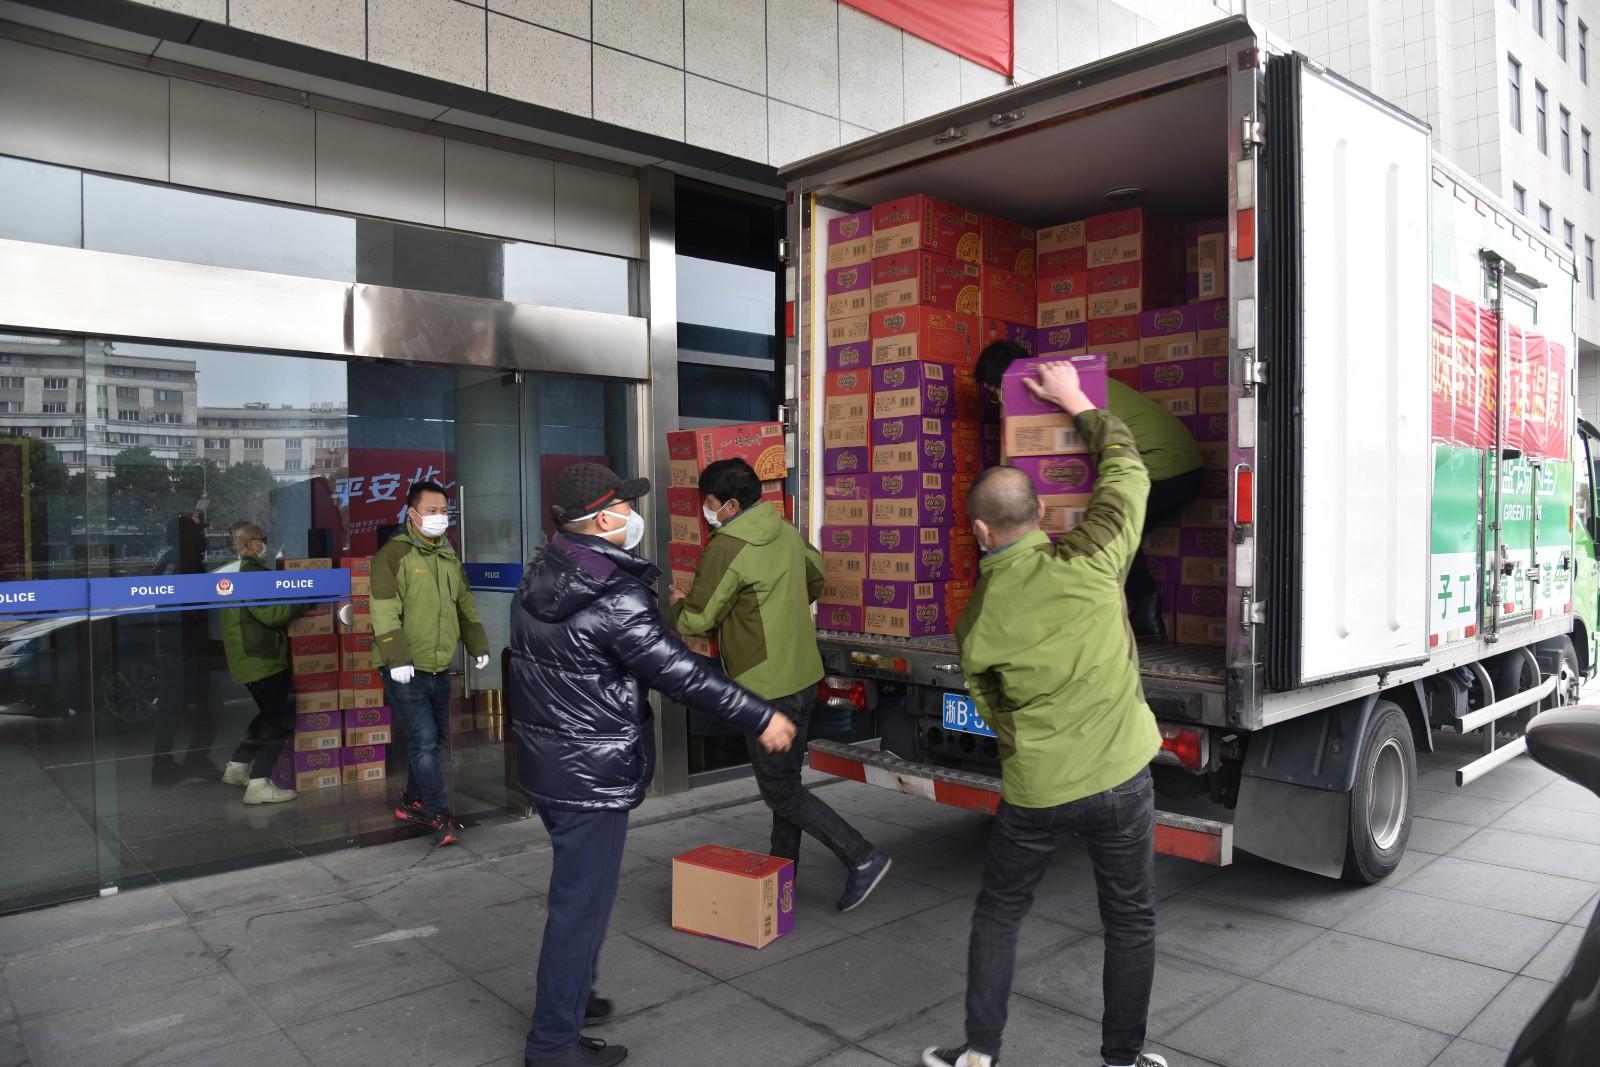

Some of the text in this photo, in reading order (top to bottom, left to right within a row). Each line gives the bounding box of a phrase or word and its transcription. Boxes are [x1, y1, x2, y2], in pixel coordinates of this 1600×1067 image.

[1503, 503, 1525, 521] GREEN
[484, 571, 501, 579] POLICE
[275, 579, 314, 589] POLICE
[131, 585, 175, 596] POLICE
